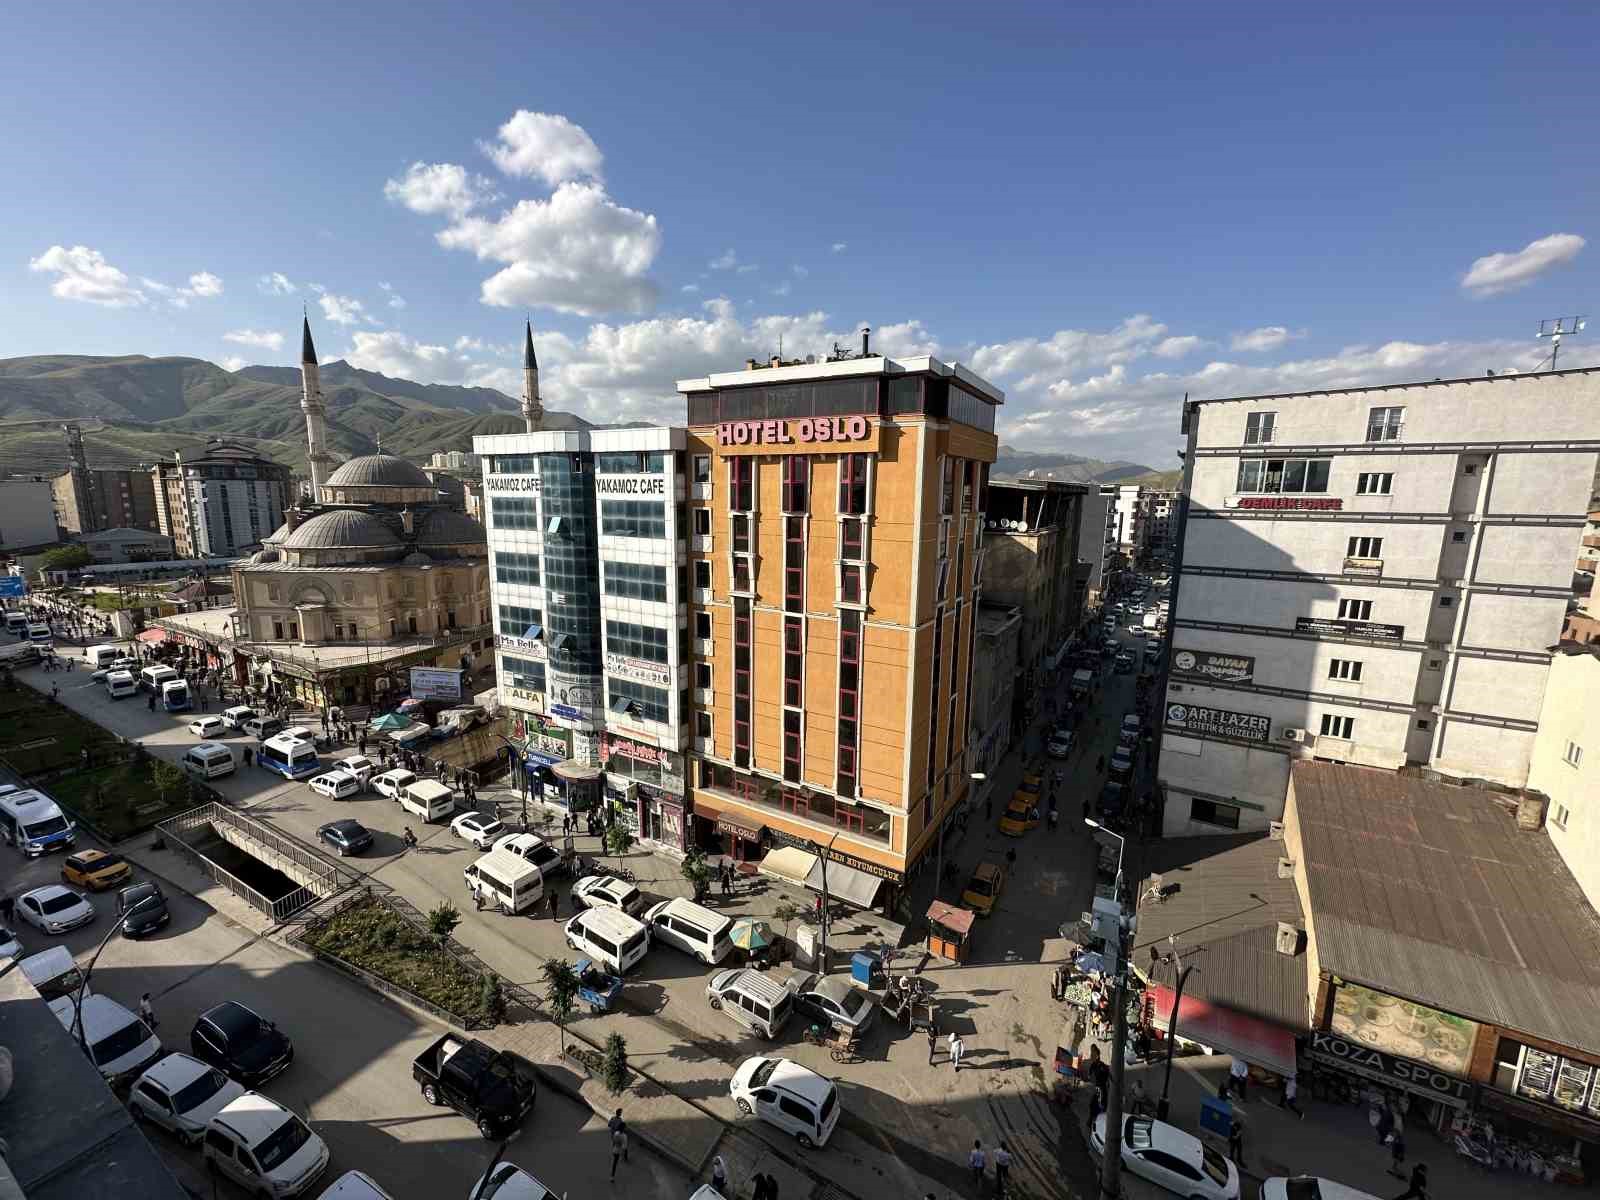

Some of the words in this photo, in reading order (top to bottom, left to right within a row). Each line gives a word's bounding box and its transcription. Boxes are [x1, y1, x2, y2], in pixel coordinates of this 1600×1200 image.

[718, 420, 791, 445] HOTEL
[799, 416, 868, 442] OSLO
[486, 478, 519, 491] YAKAMOZ
[521, 478, 541, 492] CAFE
[596, 479, 638, 494] YAKAMOZ
[640, 479, 664, 494] CAFE
[512, 689, 540, 703] ALFA
[1187, 707, 1217, 724] ART
[1219, 711, 1269, 731] LAZER
[718, 820, 739, 835] HOTEL
[738, 827, 756, 840] OSLO
[1312, 1033, 1385, 1071] KOZA
[1393, 1060, 1472, 1098] SPOT
